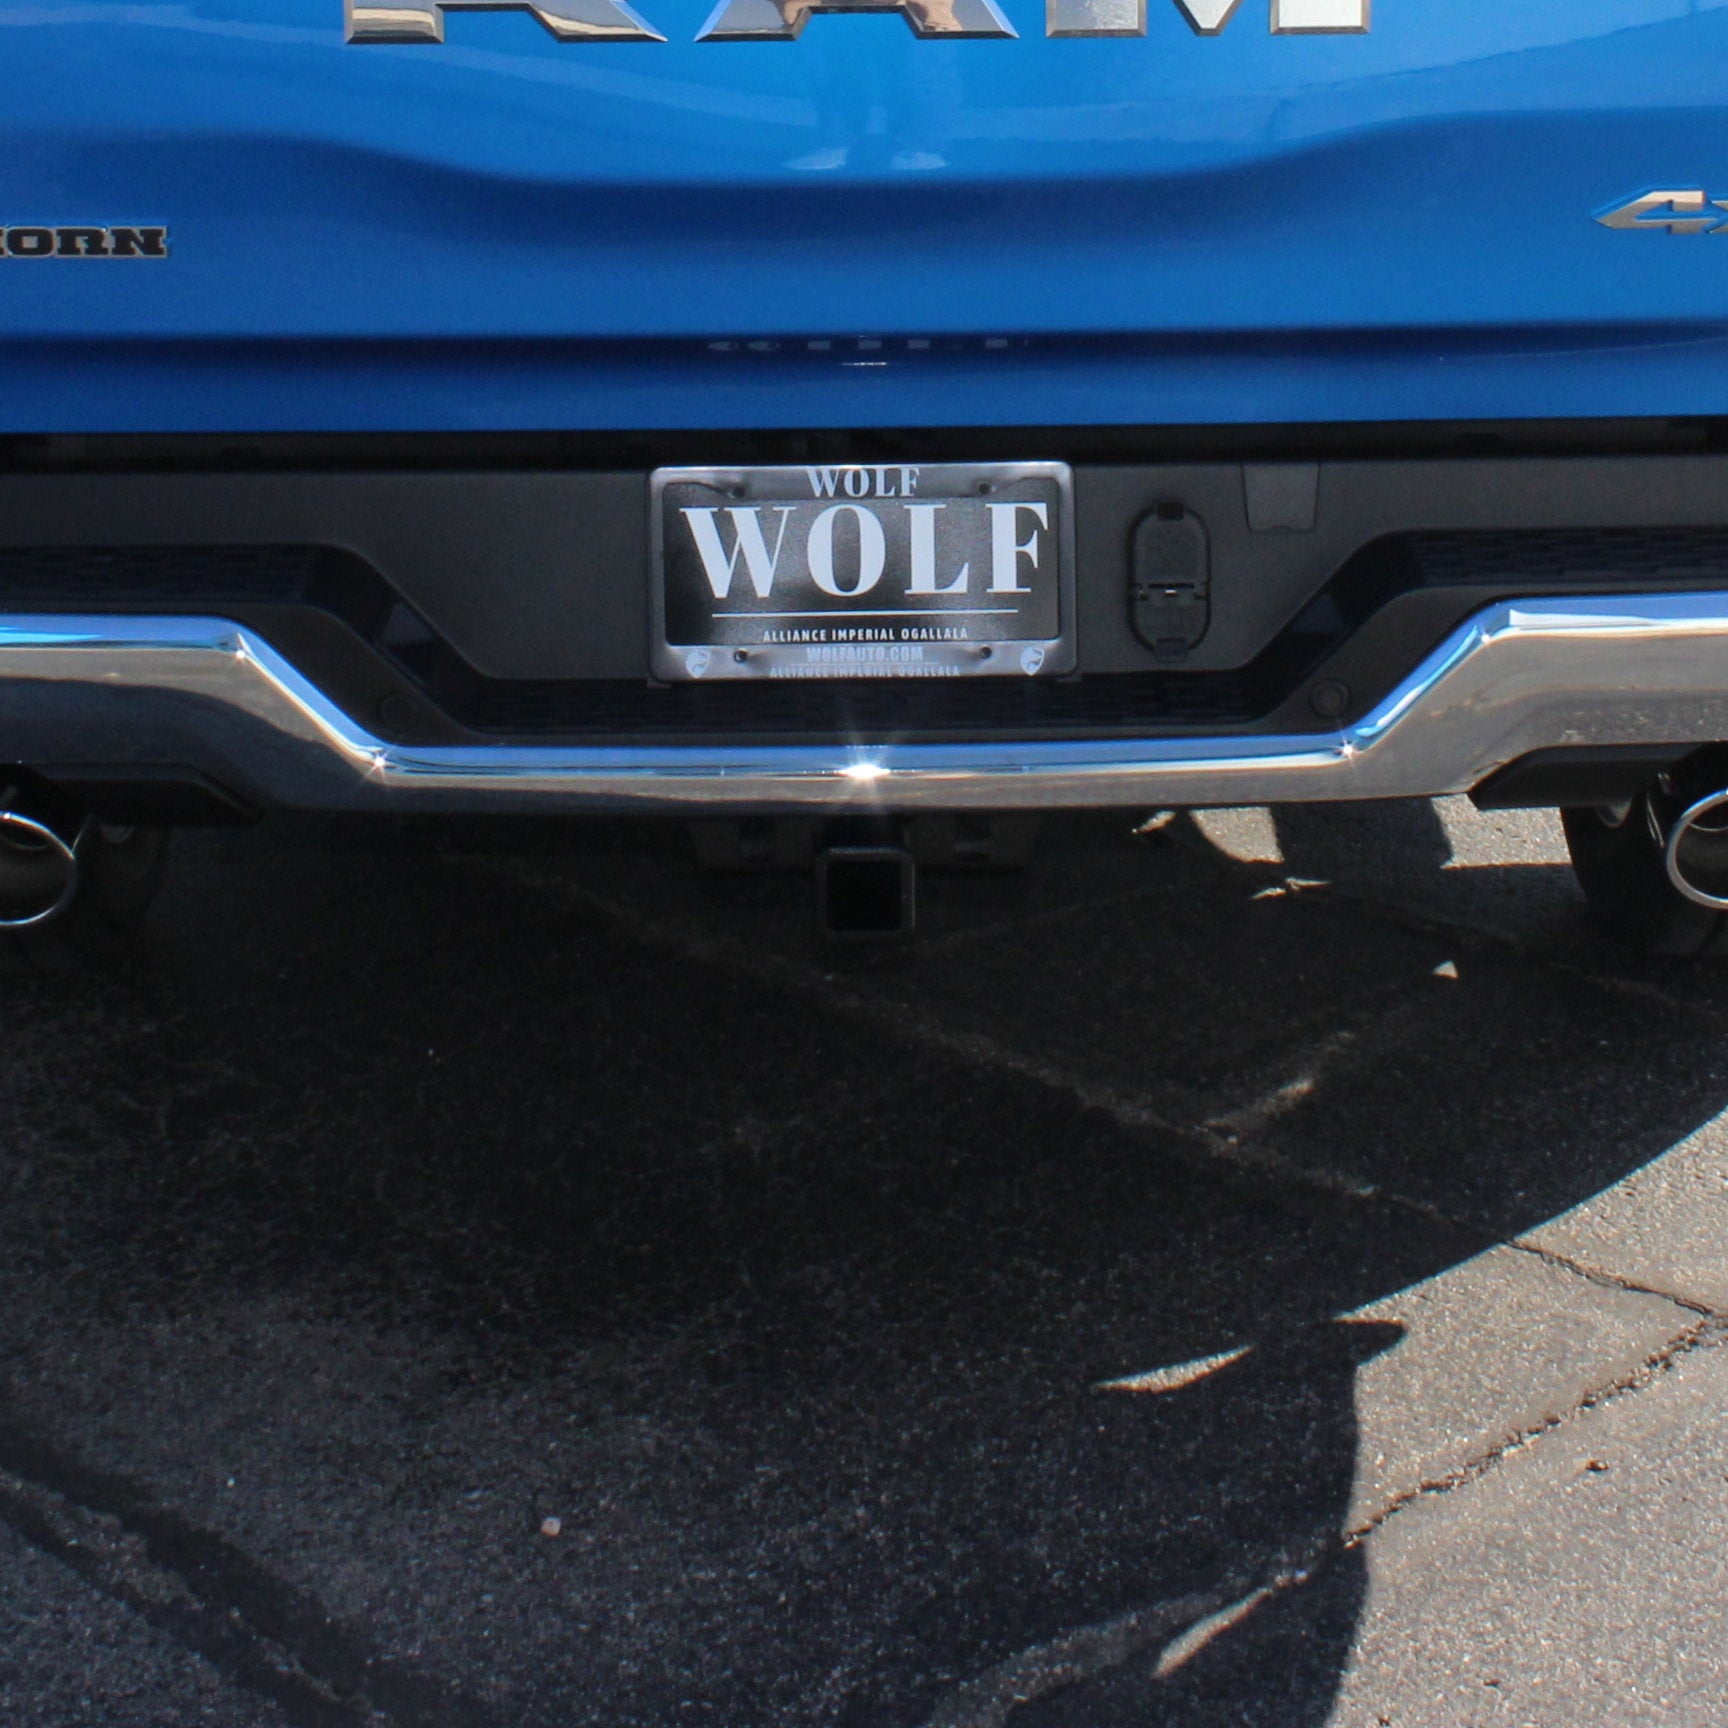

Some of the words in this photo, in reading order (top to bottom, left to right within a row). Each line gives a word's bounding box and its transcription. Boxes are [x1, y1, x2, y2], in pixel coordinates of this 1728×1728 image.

[806, 467, 921, 499] WOLF
[679, 502, 1049, 599] WOLF
[762, 629, 827, 643] ALLIANCE
[831, 627, 896, 641] IMPERIAL
[901, 627, 969, 640] OGALLALA
[805, 645, 924, 663] WOLFAUTO.COM
